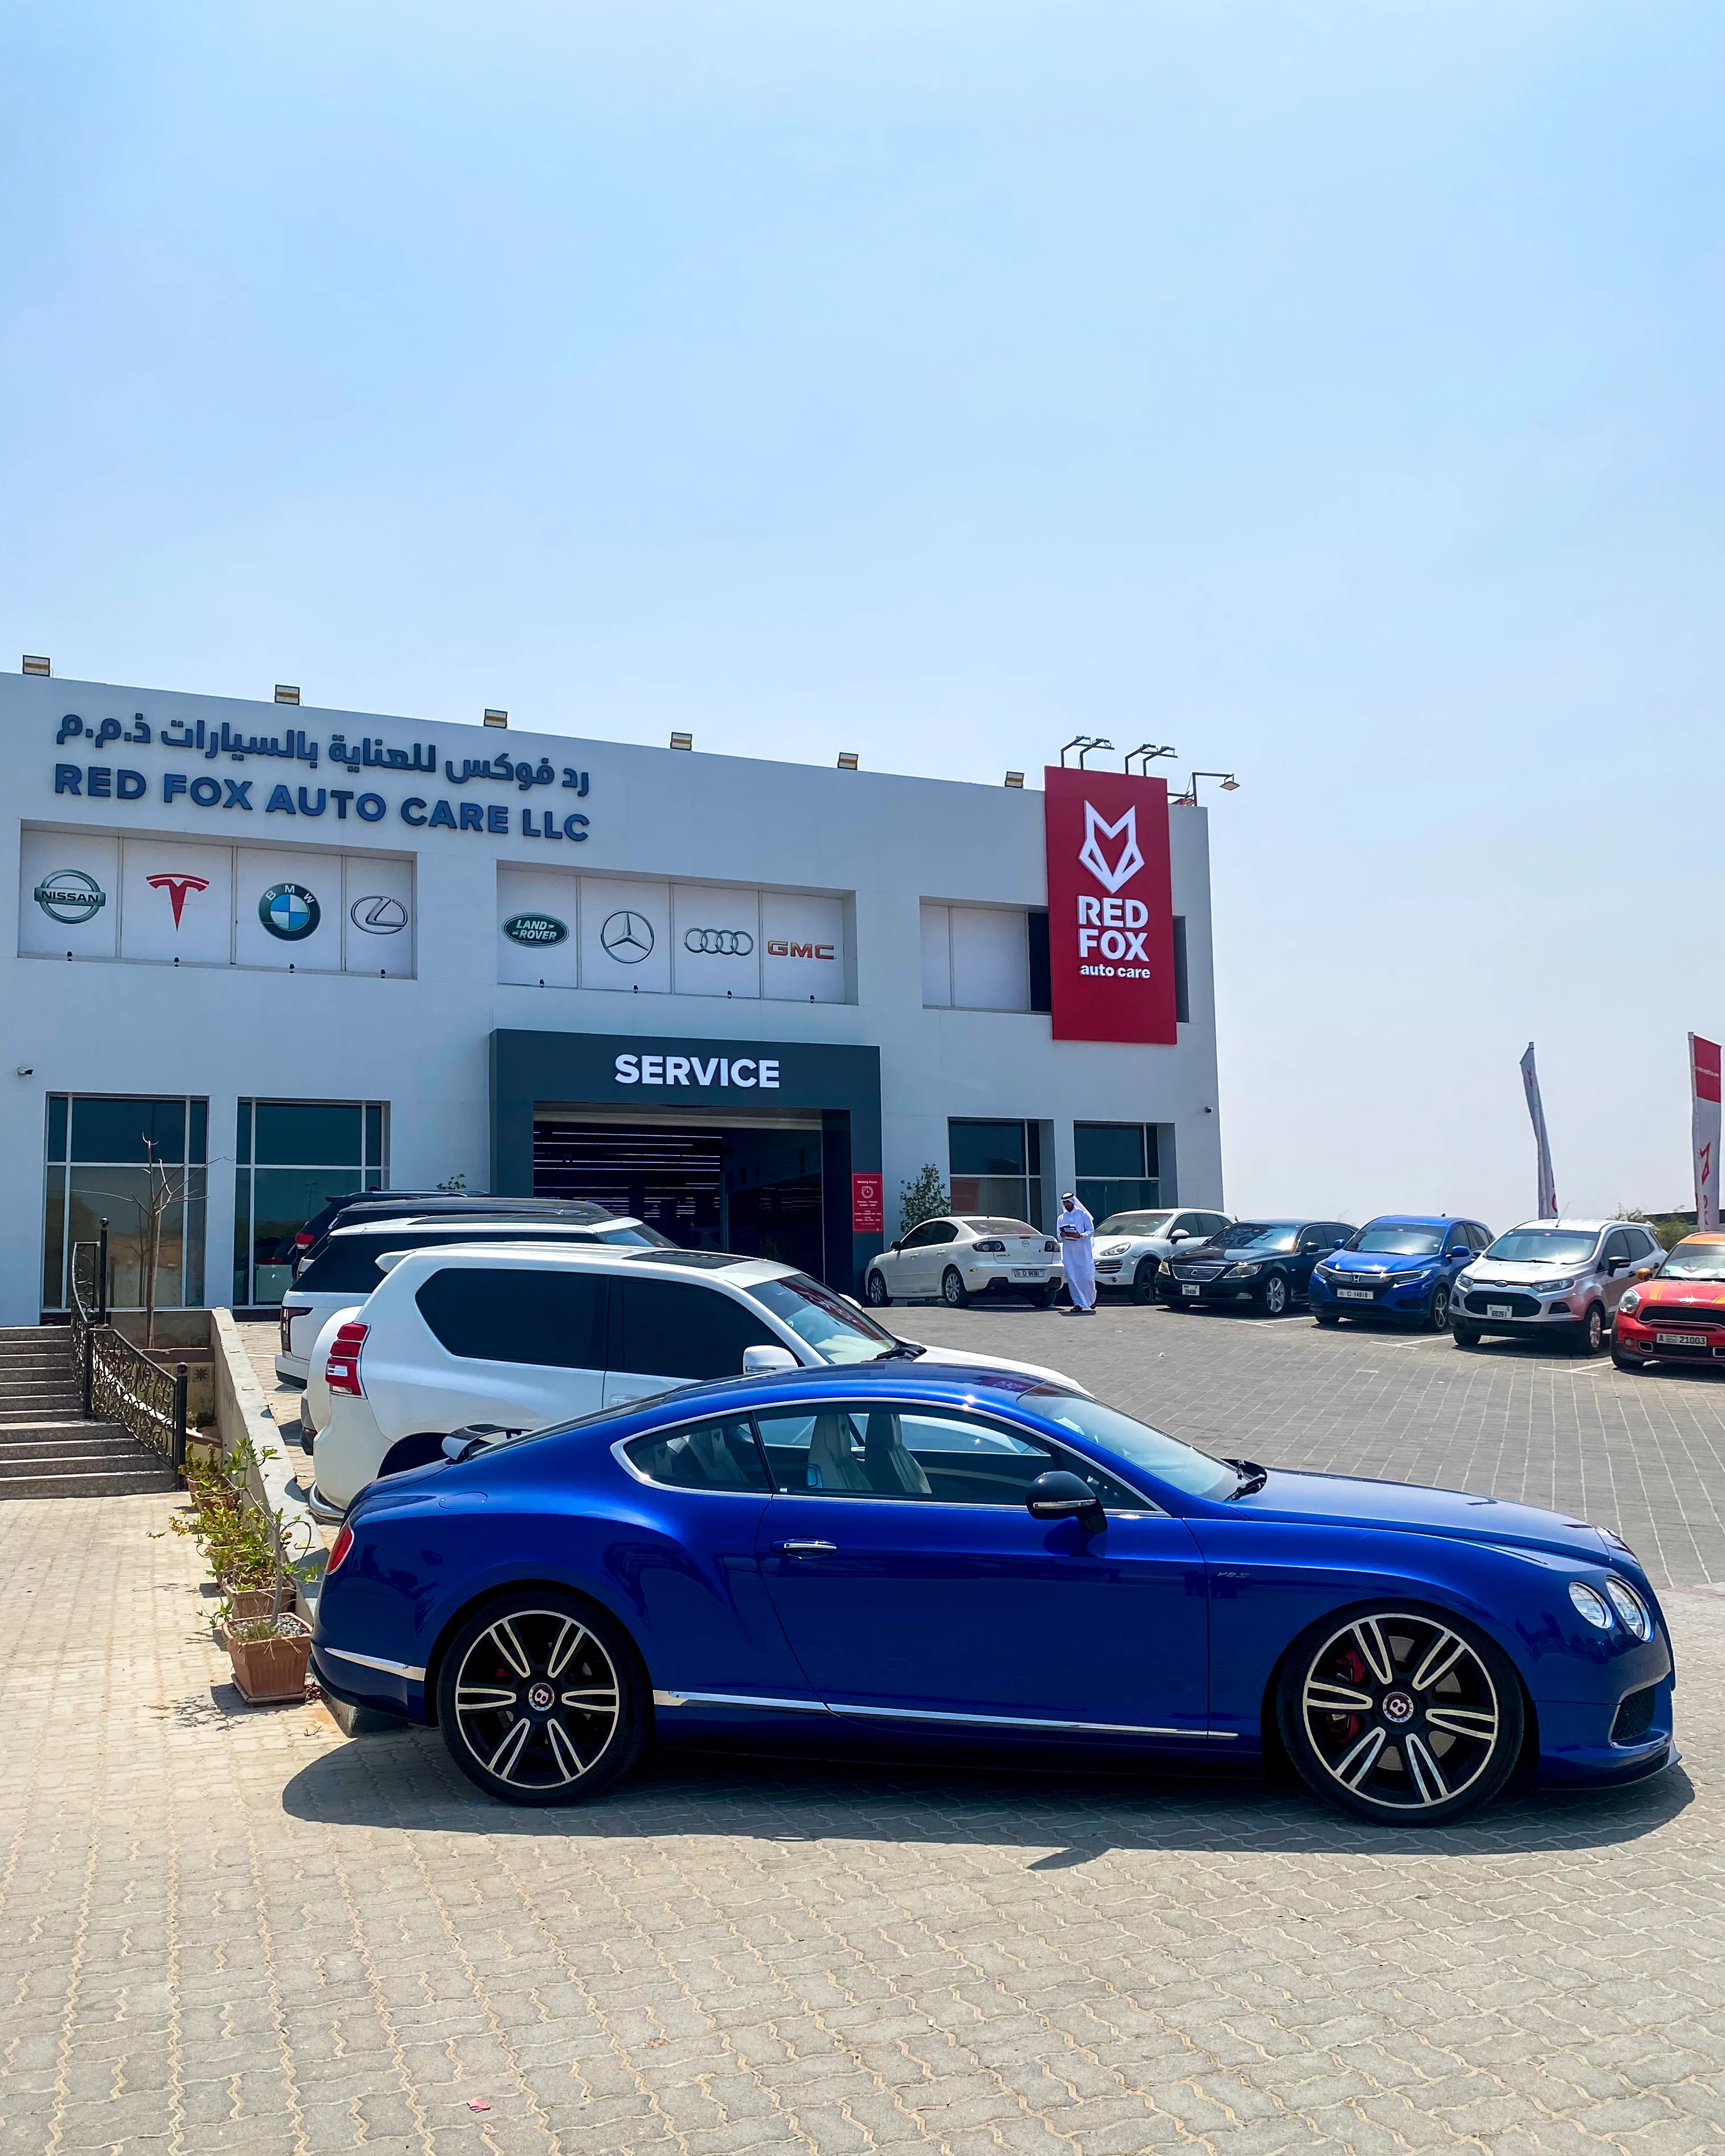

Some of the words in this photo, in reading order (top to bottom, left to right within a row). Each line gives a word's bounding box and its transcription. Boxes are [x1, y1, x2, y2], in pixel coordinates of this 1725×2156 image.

[161, 720, 318, 768] بالسيارات
[329, 734, 436, 772] للعناية
[446, 753, 554, 791] فوكس
[562, 767, 589, 797] رد
[55, 763, 147, 799] RED
[163, 773, 253, 810] FOX
[265, 784, 386, 821] AUTO
[400, 797, 508, 834] CARE
[523, 808, 590, 841] LLC
[41, 890, 99, 903] NISSAN
[265, 885, 315, 903] BMW
[516, 919, 548, 930] LAND
[1077, 895, 1149, 929] RED
[519, 929, 557, 941] ROVER
[767, 940, 835, 960] GMC
[1078, 928, 1150, 962] FOX
[1080, 964, 1115, 976] auto
[1116, 967, 1151, 979] care
[614, 1053, 780, 1088] SERVICE
[1679, 1336, 1705, 1345] 21003
